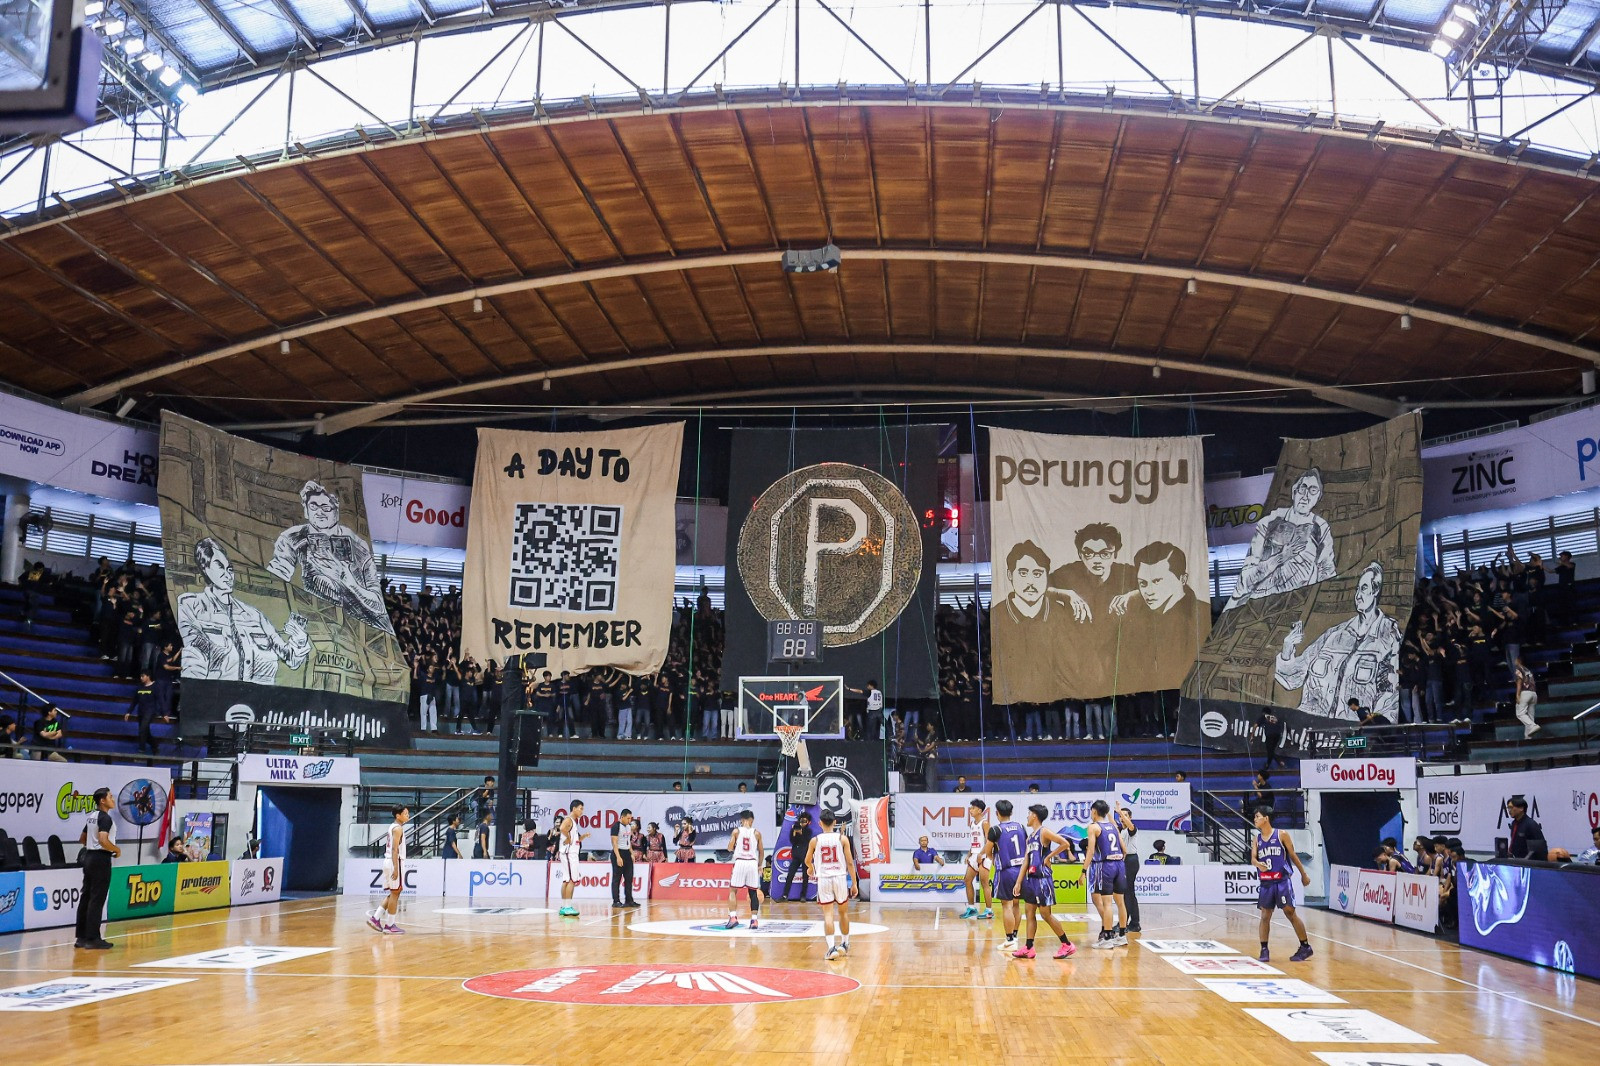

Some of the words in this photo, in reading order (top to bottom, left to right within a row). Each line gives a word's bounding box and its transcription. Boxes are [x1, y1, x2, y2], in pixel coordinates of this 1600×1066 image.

[0, 429, 44, 447] DOWNLOAD
[45, 441, 61, 451] APP
[19, 443, 39, 454] NOW
[123, 449, 159, 469] HO
[503, 452, 525, 479] A
[537, 447, 594, 480] DAY
[598, 449, 630, 482] TO
[995, 455, 1189, 505] perunggu
[1451, 456, 1515, 495] ZINC
[405, 499, 465, 528] Good
[491, 617, 642, 650] REMEMBER
[759, 693, 774, 701] One
[292, 736, 310, 744] EXIT
[1347, 738, 1364, 747] EXIT
[266, 758, 299, 769] ULTRA
[825, 756, 847, 769] DREI
[270, 769, 297, 780] MILK
[1330, 763, 1365, 782] Good
[1367, 763, 1396, 785] Day
[823, 782, 843, 814] 3
[1140, 788, 1179, 797] mayapada
[1140, 797, 1167, 805] hospital
[0, 792, 44, 813] gopay
[1051, 800, 1094, 823] AQU
[668, 812, 682, 821] PAKE
[860, 805, 869, 834] CREAM
[1429, 807, 1459, 825] Bioré
[701, 822, 720, 833] MAKIN
[931, 831, 971, 839] DISTRIBUT
[742, 838, 750, 851] 5
[861, 841, 871, 859] HOT
[1010, 834, 1021, 856] 1
[1107, 833, 1118, 851] 2
[820, 845, 839, 863] 21
[180, 875, 222, 891] proteam
[369, 869, 418, 889] ZC
[469, 862, 523, 897] posh
[678, 878, 731, 889] HOND
[1135, 875, 1177, 885] ayapada
[1224, 871, 1257, 880] MEN
[128, 874, 162, 907] Taro
[879, 880, 966, 893] BEAT
[1134, 883, 1162, 893] ospital
[1403, 882, 1427, 908] MPM
[52, 887, 83, 910] gop
[1363, 883, 1379, 904] Good
[1379, 885, 1392, 911] Day
